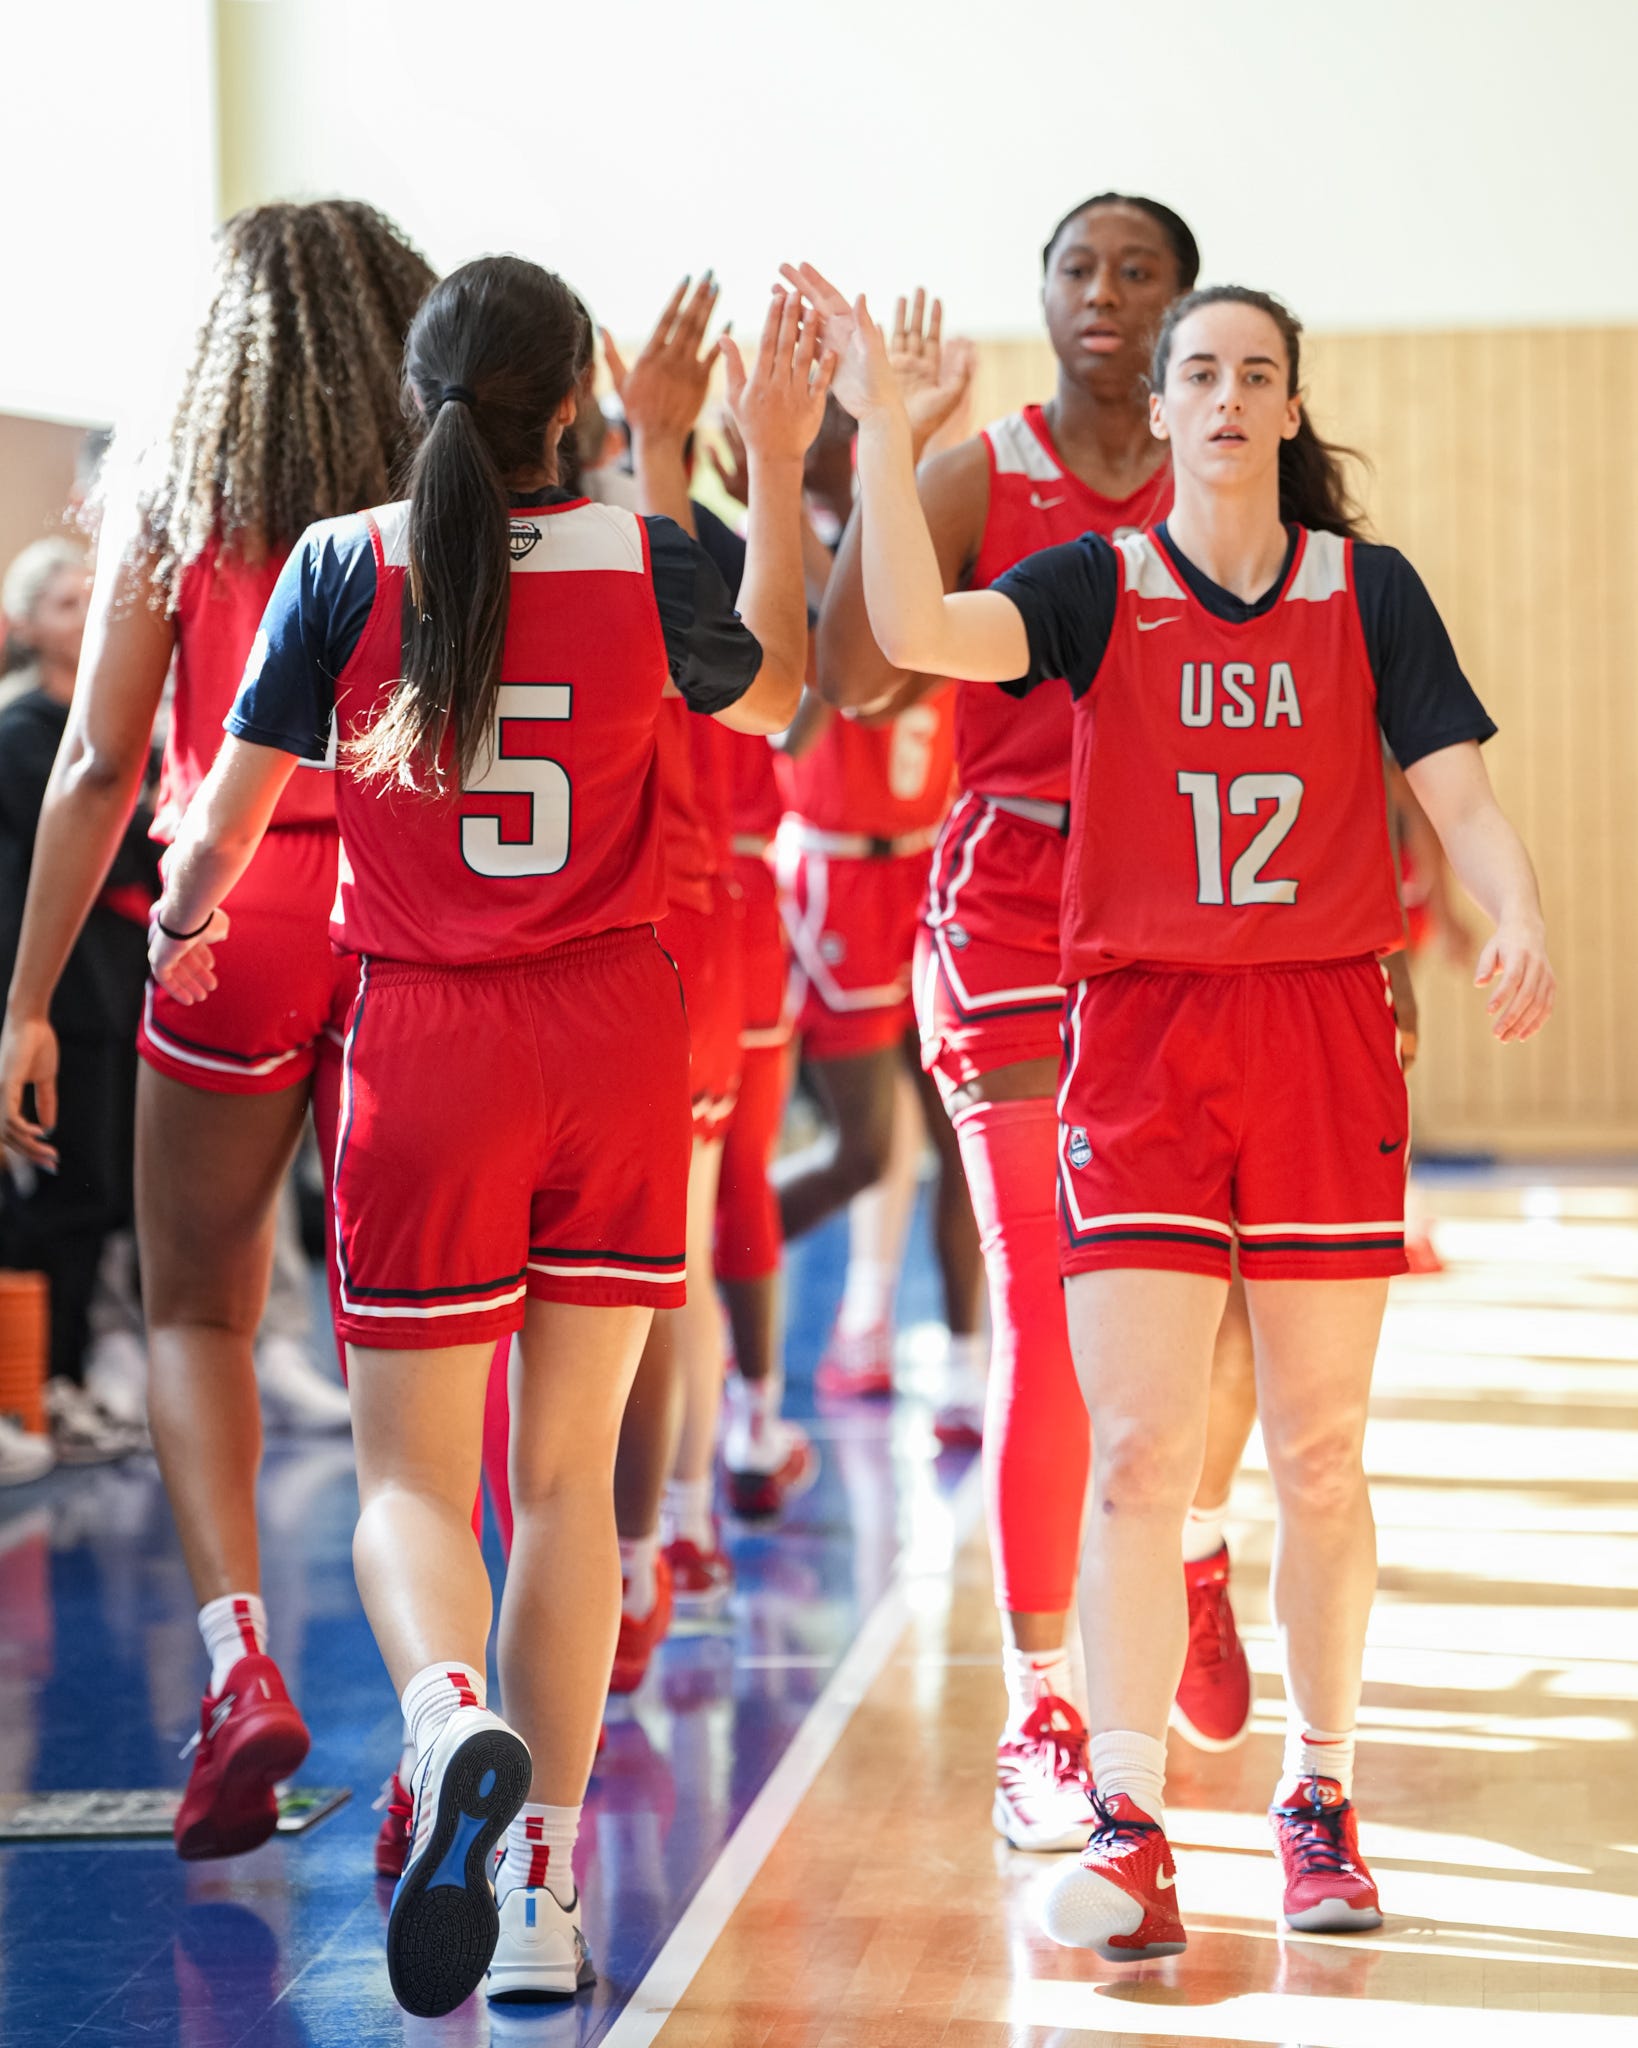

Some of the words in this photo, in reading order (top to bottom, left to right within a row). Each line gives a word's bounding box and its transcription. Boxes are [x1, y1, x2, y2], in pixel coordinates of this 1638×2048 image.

[1180, 662, 1302, 728] USA
[460, 683, 573, 878] 5
[1177, 770, 1304, 906] 12
